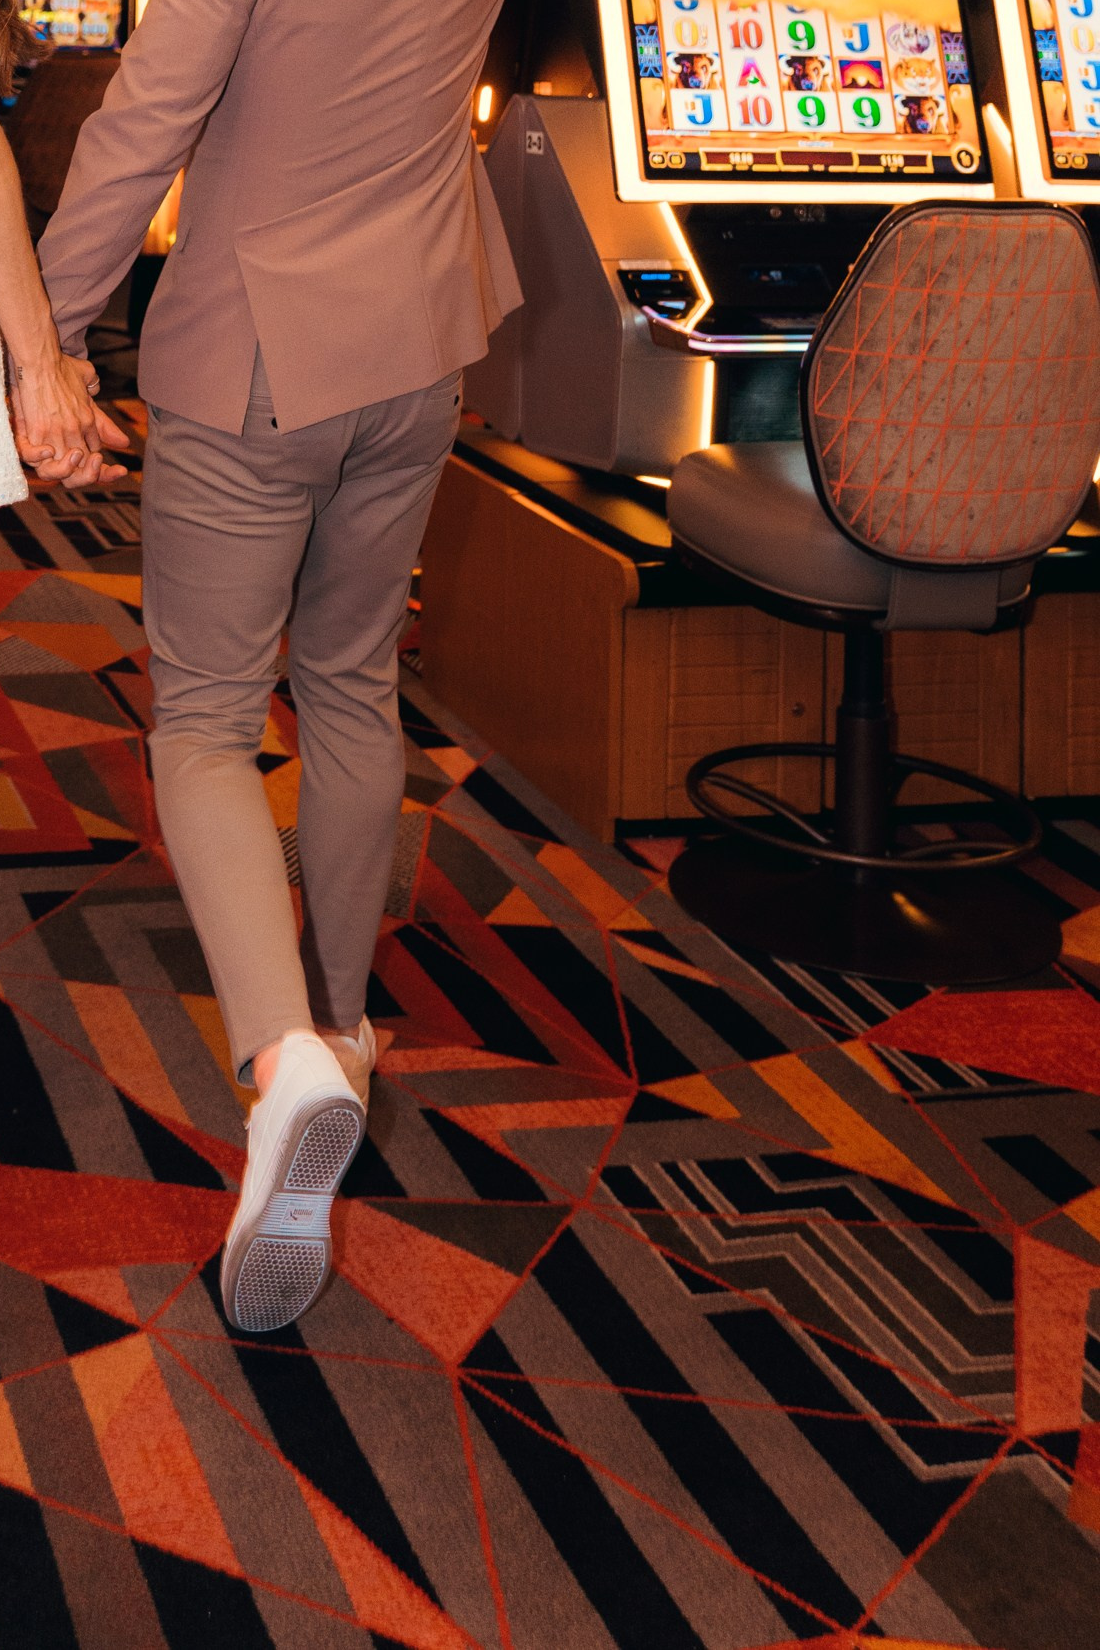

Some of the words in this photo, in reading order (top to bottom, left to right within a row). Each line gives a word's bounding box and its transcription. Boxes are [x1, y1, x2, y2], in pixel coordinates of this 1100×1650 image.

[729, 19, 763, 50] 10
[788, 19, 816, 51] 9
[844, 22, 870, 53] J
[737, 56, 768, 88] A
[686, 93, 713, 125] J
[739, 95, 773, 127] 10
[796, 95, 826, 127] 9
[852, 96, 881, 127] 9
